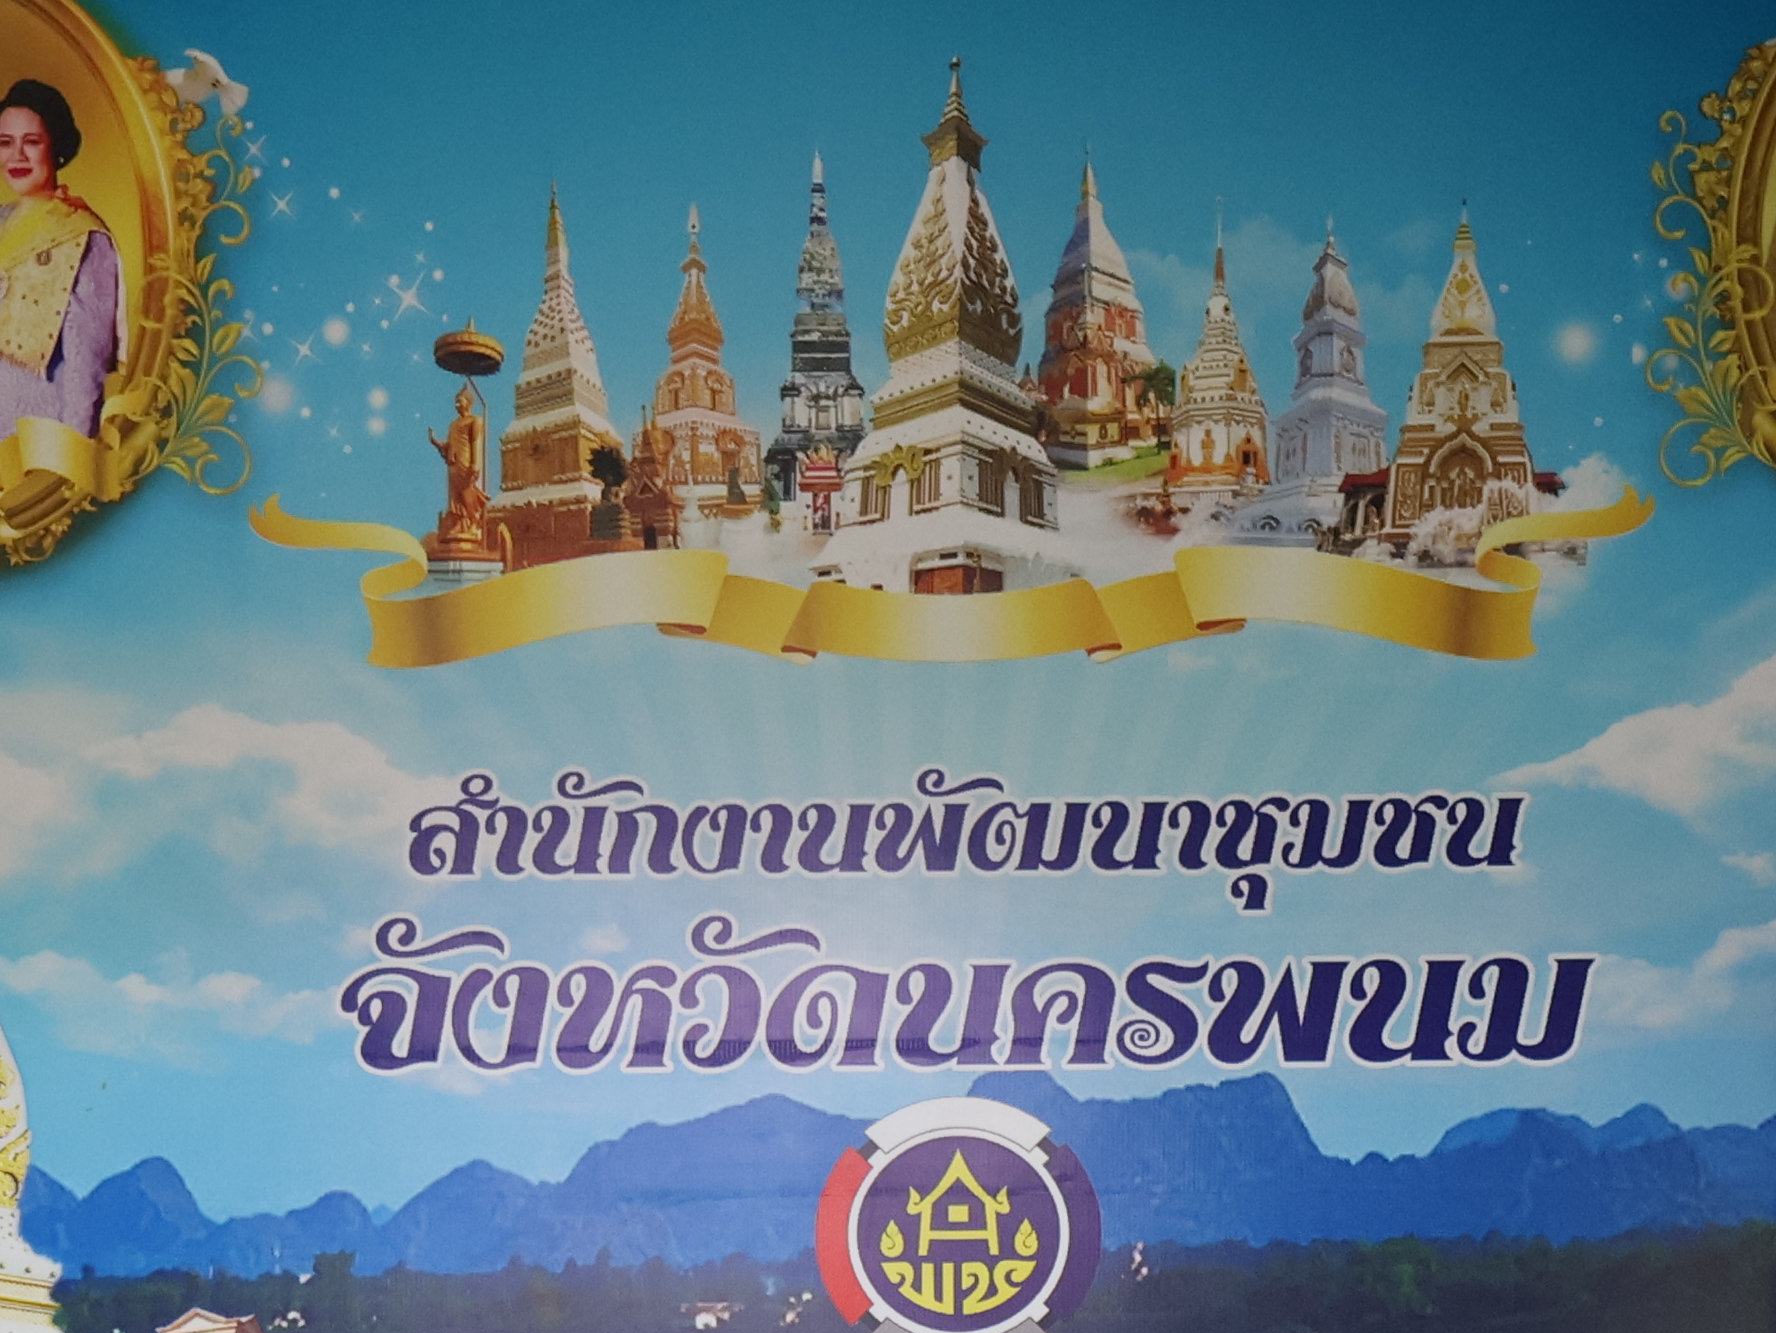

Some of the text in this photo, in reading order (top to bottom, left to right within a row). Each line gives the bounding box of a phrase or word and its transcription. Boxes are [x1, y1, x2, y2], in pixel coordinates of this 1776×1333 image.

[407, 768, 1524, 911] สำนักงานพัฒนาชุมชน
[339, 913, 1597, 1075] จังหวัดนครพนม
